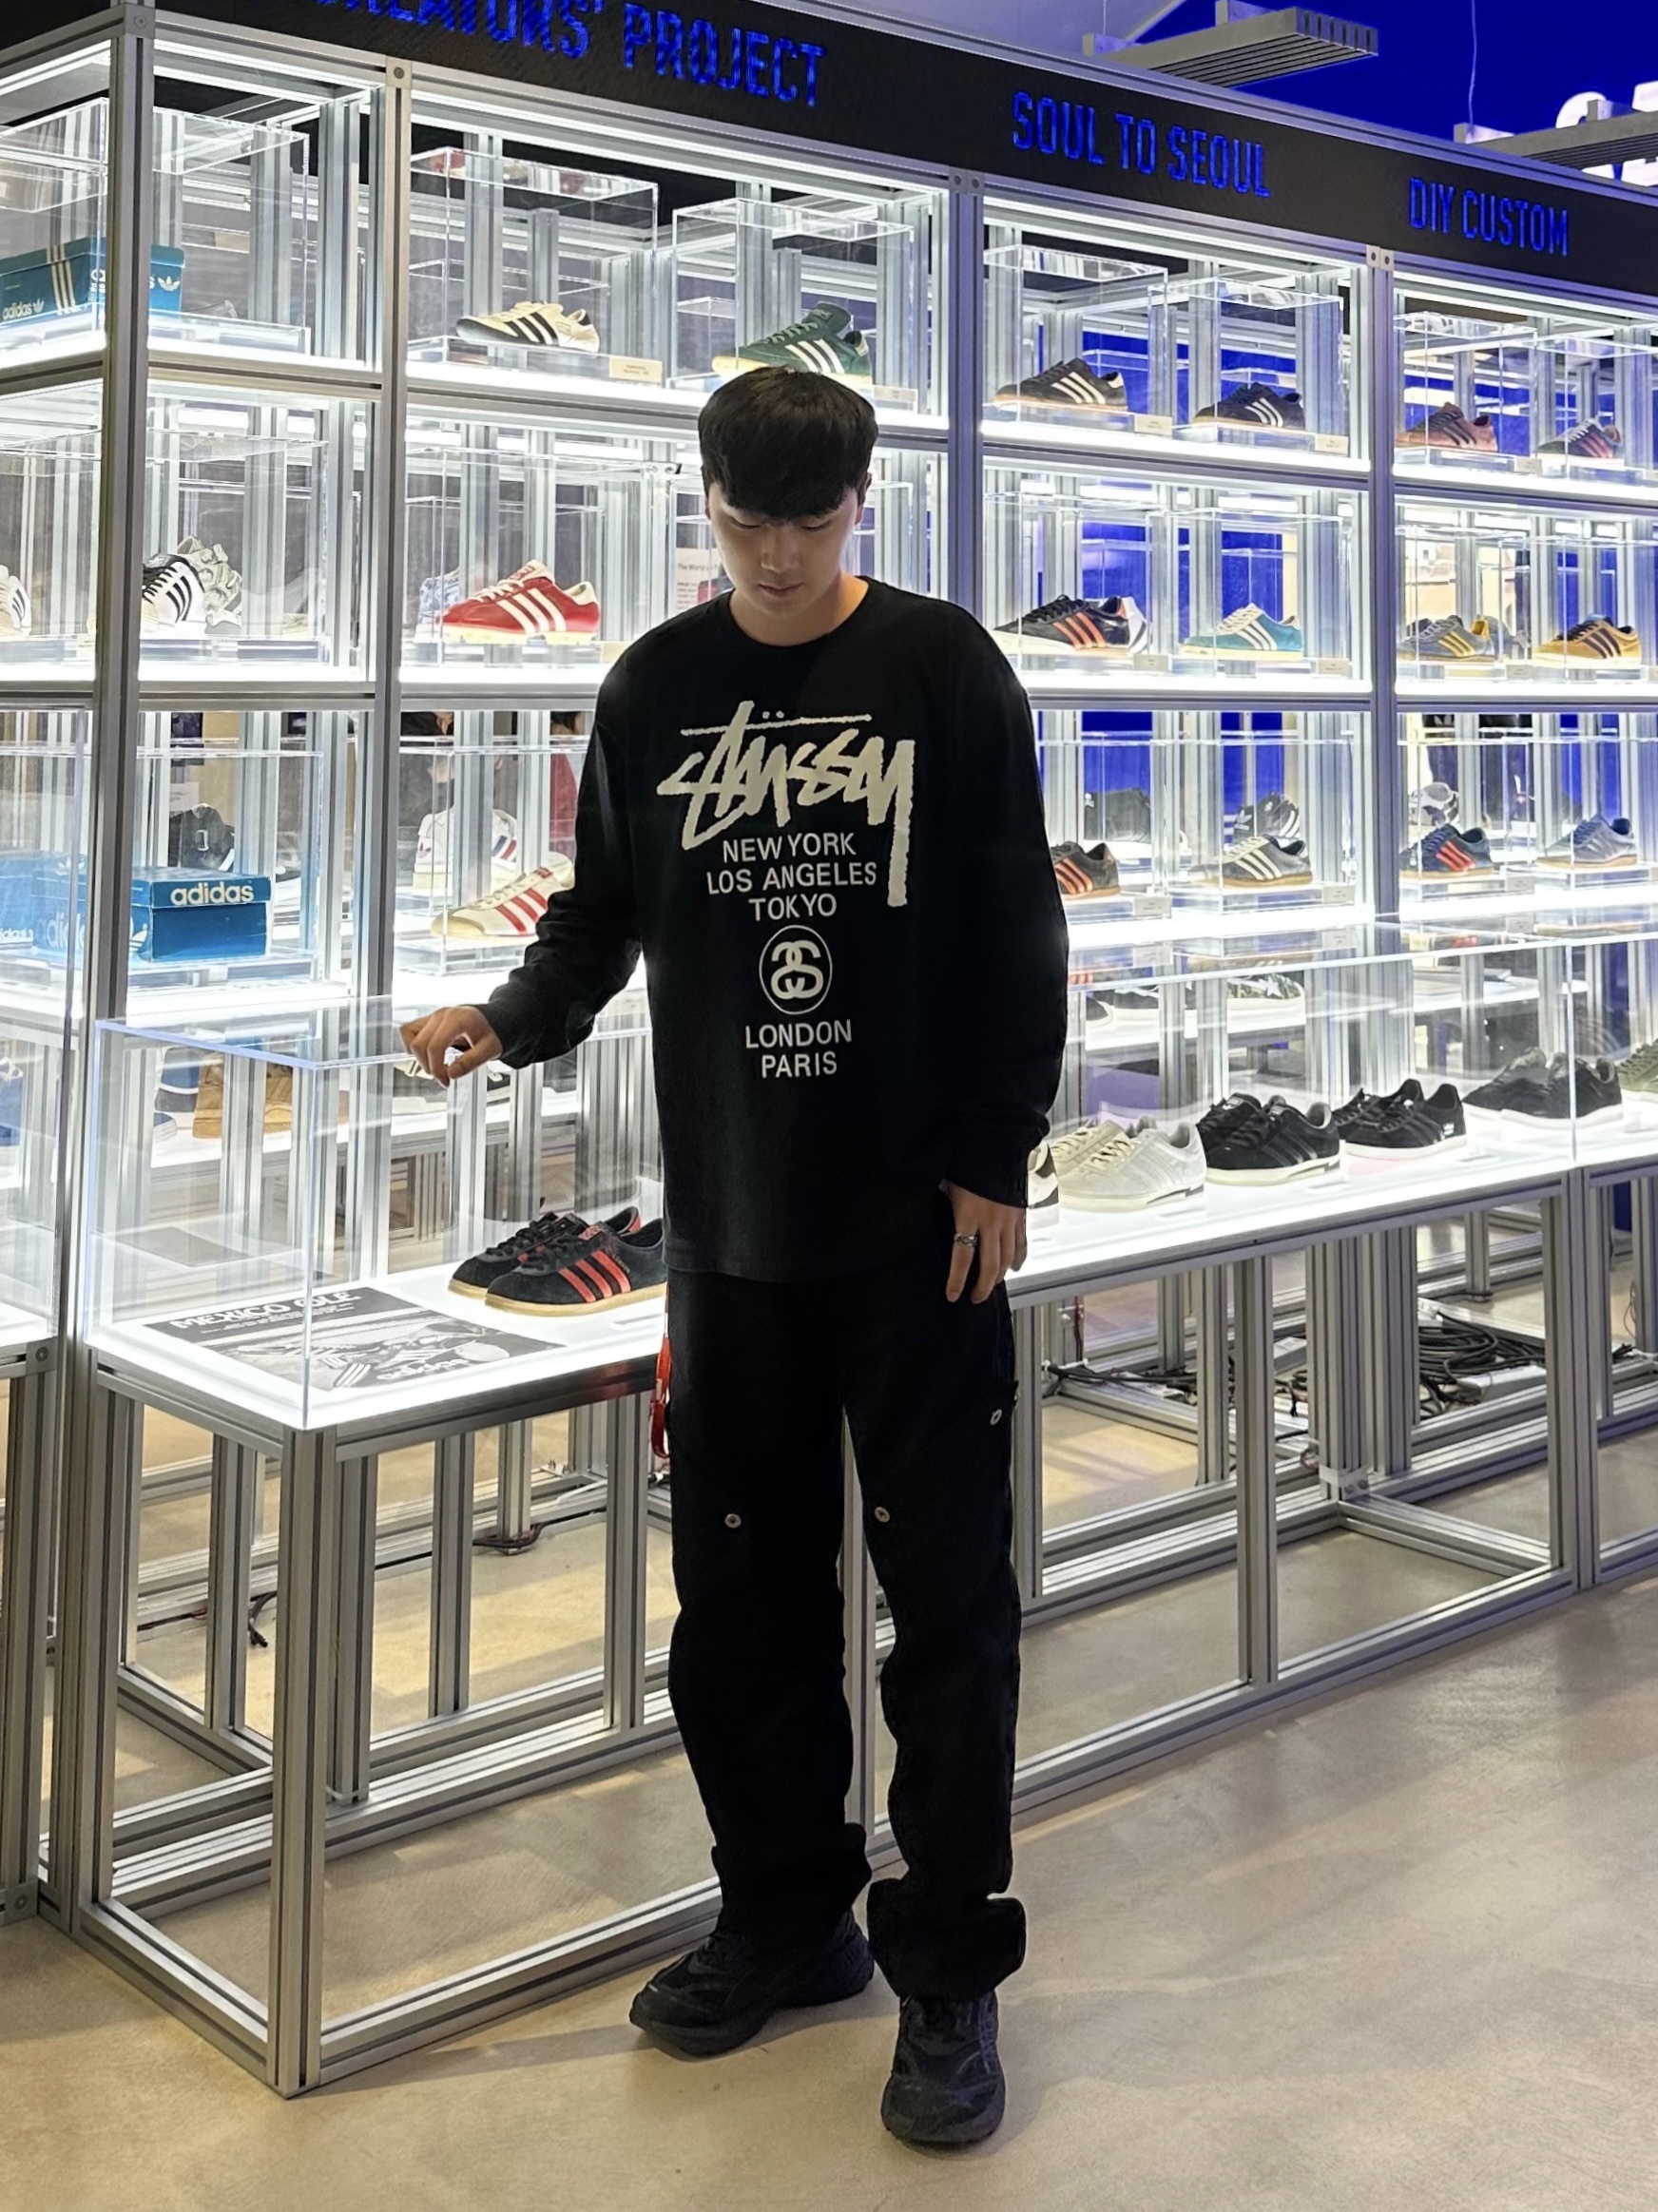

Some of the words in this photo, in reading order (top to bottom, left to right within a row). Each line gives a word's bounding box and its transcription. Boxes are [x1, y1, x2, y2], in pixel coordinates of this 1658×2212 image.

[623, 3, 826, 107] PROJECT
[1012, 91, 1106, 165] SOUL
[1114, 112, 1157, 175] TO
[1167, 125, 1272, 198] SEOUL
[1410, 176, 1455, 234] DIY
[1462, 189, 1569, 258] CUSTOM
[2, 301, 32, 321] adidas
[723, 837, 783, 863] NEW
[788, 833, 857, 857] YORK
[706, 868, 753, 894] LOS
[762, 862, 877, 891] ANGELES
[170, 881, 254, 905] adidas
[748, 893, 837, 921] TOKYO
[745, 1019, 853, 1048] LONDON
[761, 1050, 838, 1078] PARIS
[169, 1303, 291, 1329] MEXICO
